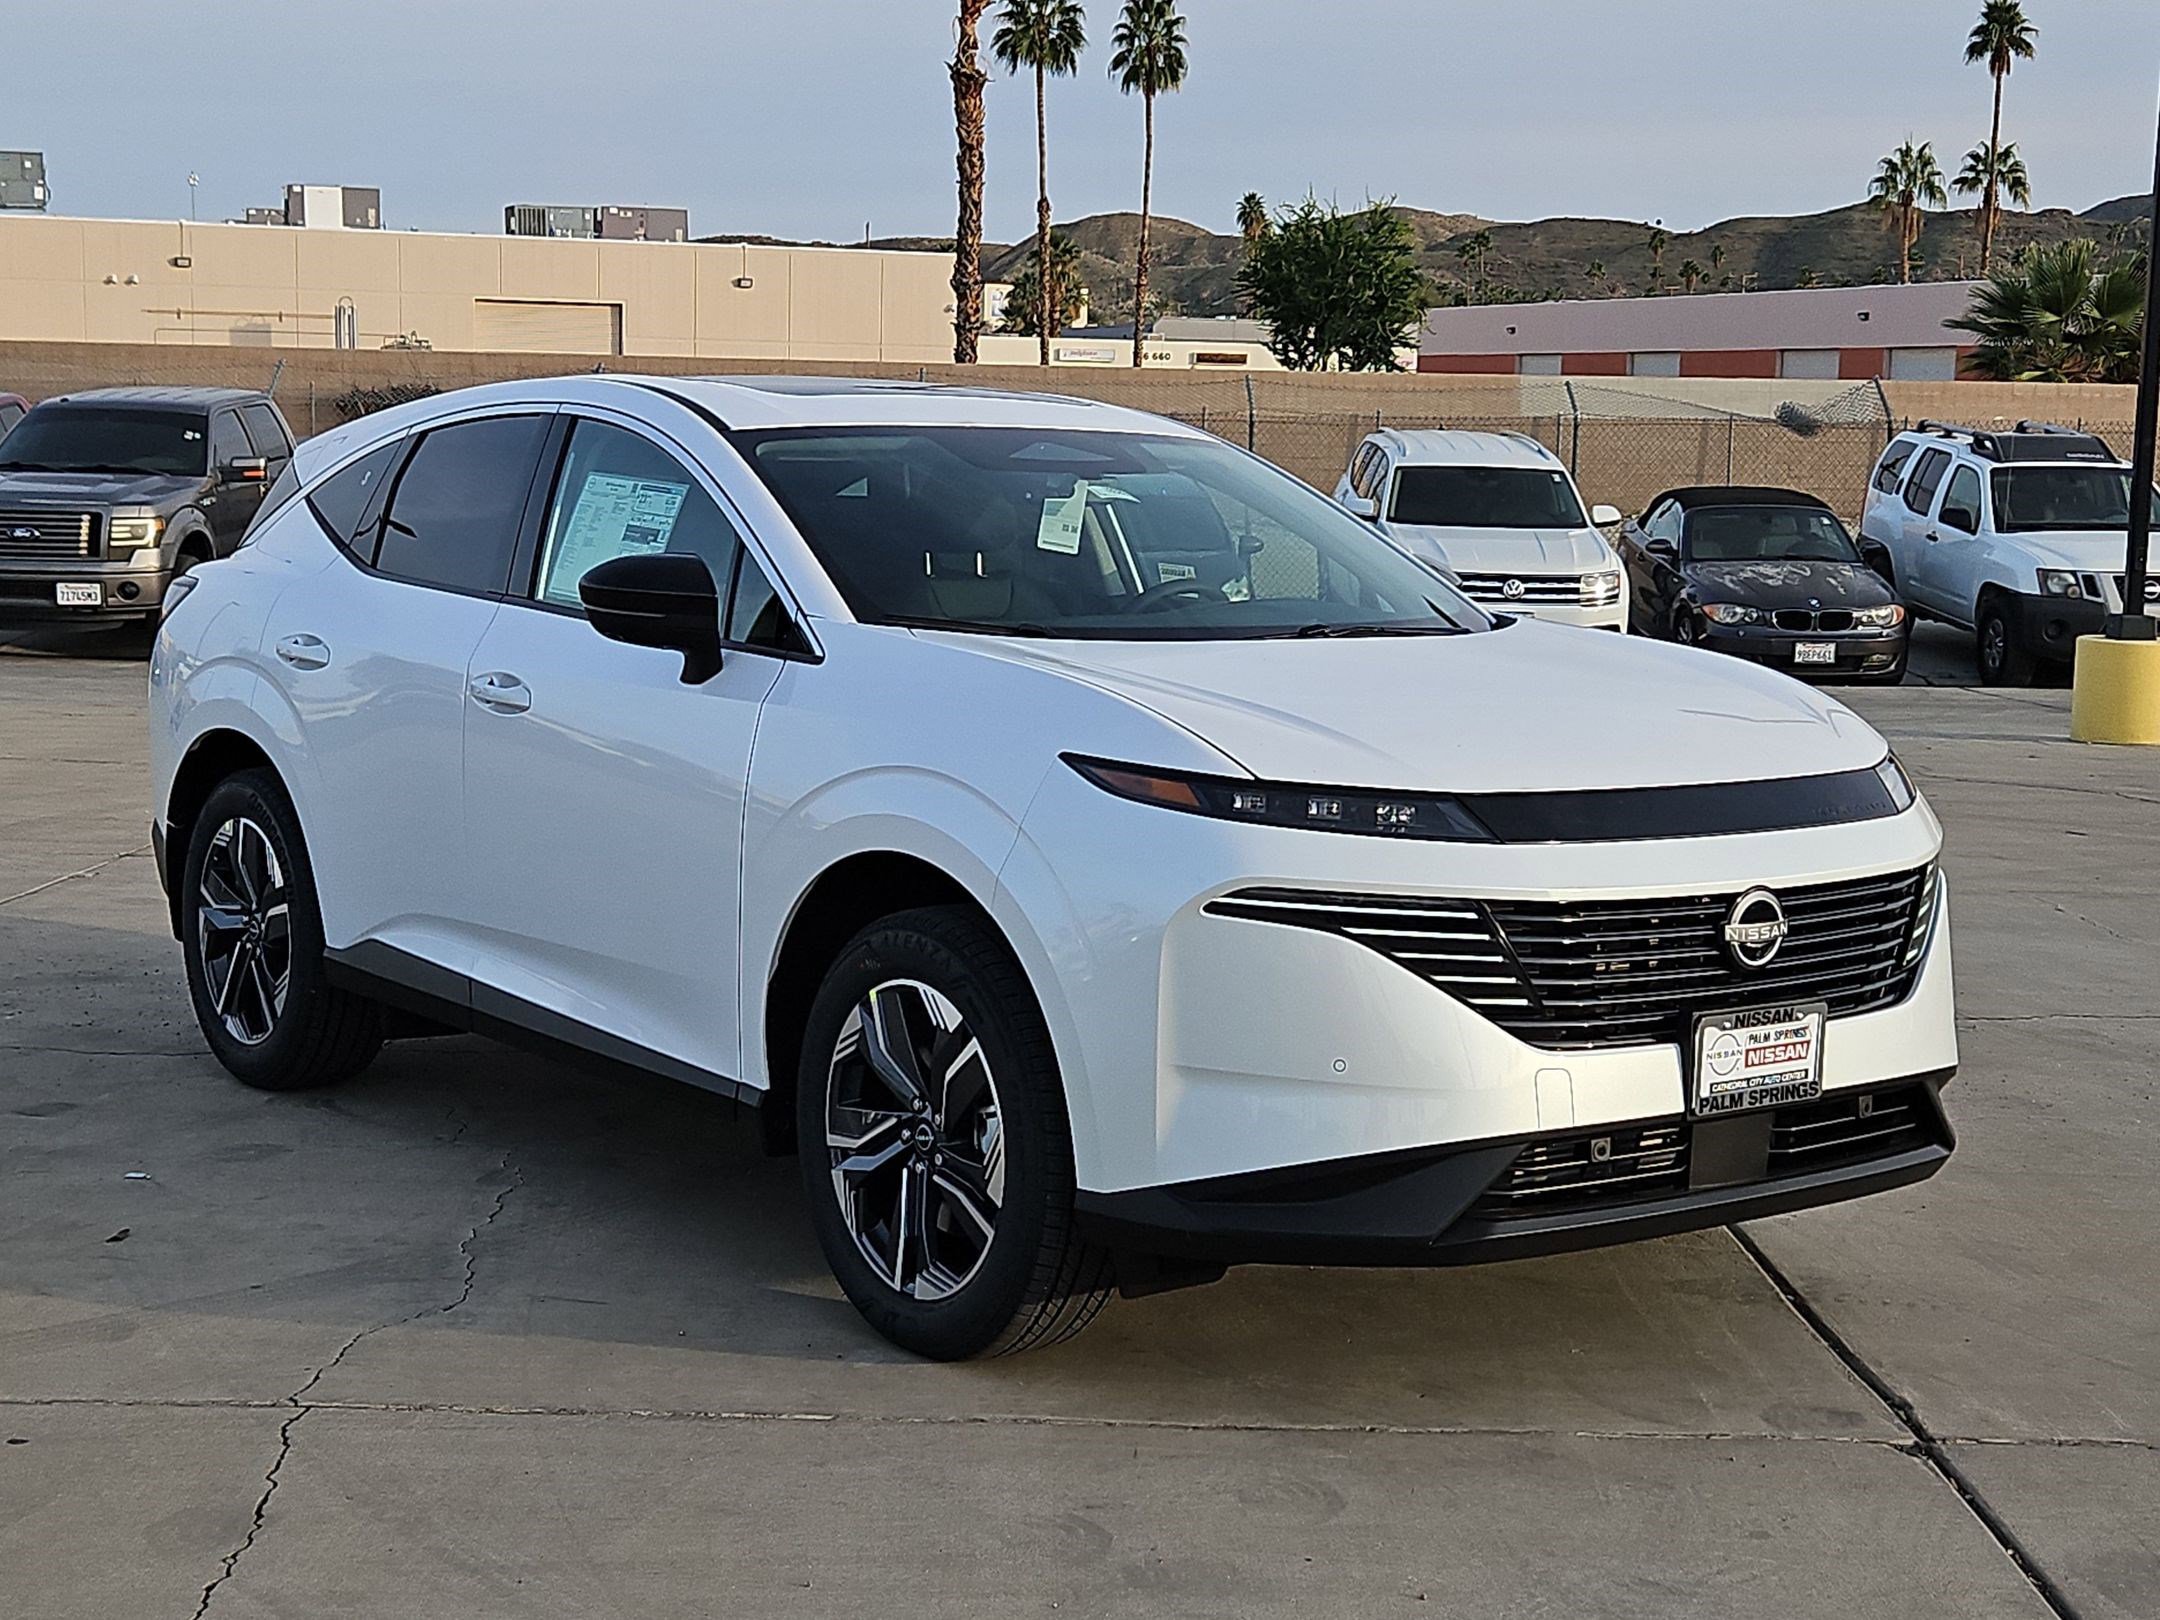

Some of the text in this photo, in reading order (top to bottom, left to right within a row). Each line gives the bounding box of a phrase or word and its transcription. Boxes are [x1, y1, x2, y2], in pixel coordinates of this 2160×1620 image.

[1725, 920, 1789, 942] NISSAN
[1733, 1008, 1795, 1029] NISSAN
[1748, 1031, 1771, 1045] PALM
[1706, 1048, 1743, 1060] NISSAN
[1746, 1042, 1809, 1066] NISSAN
[1699, 1080, 1819, 1114] PALM SPRINGS
